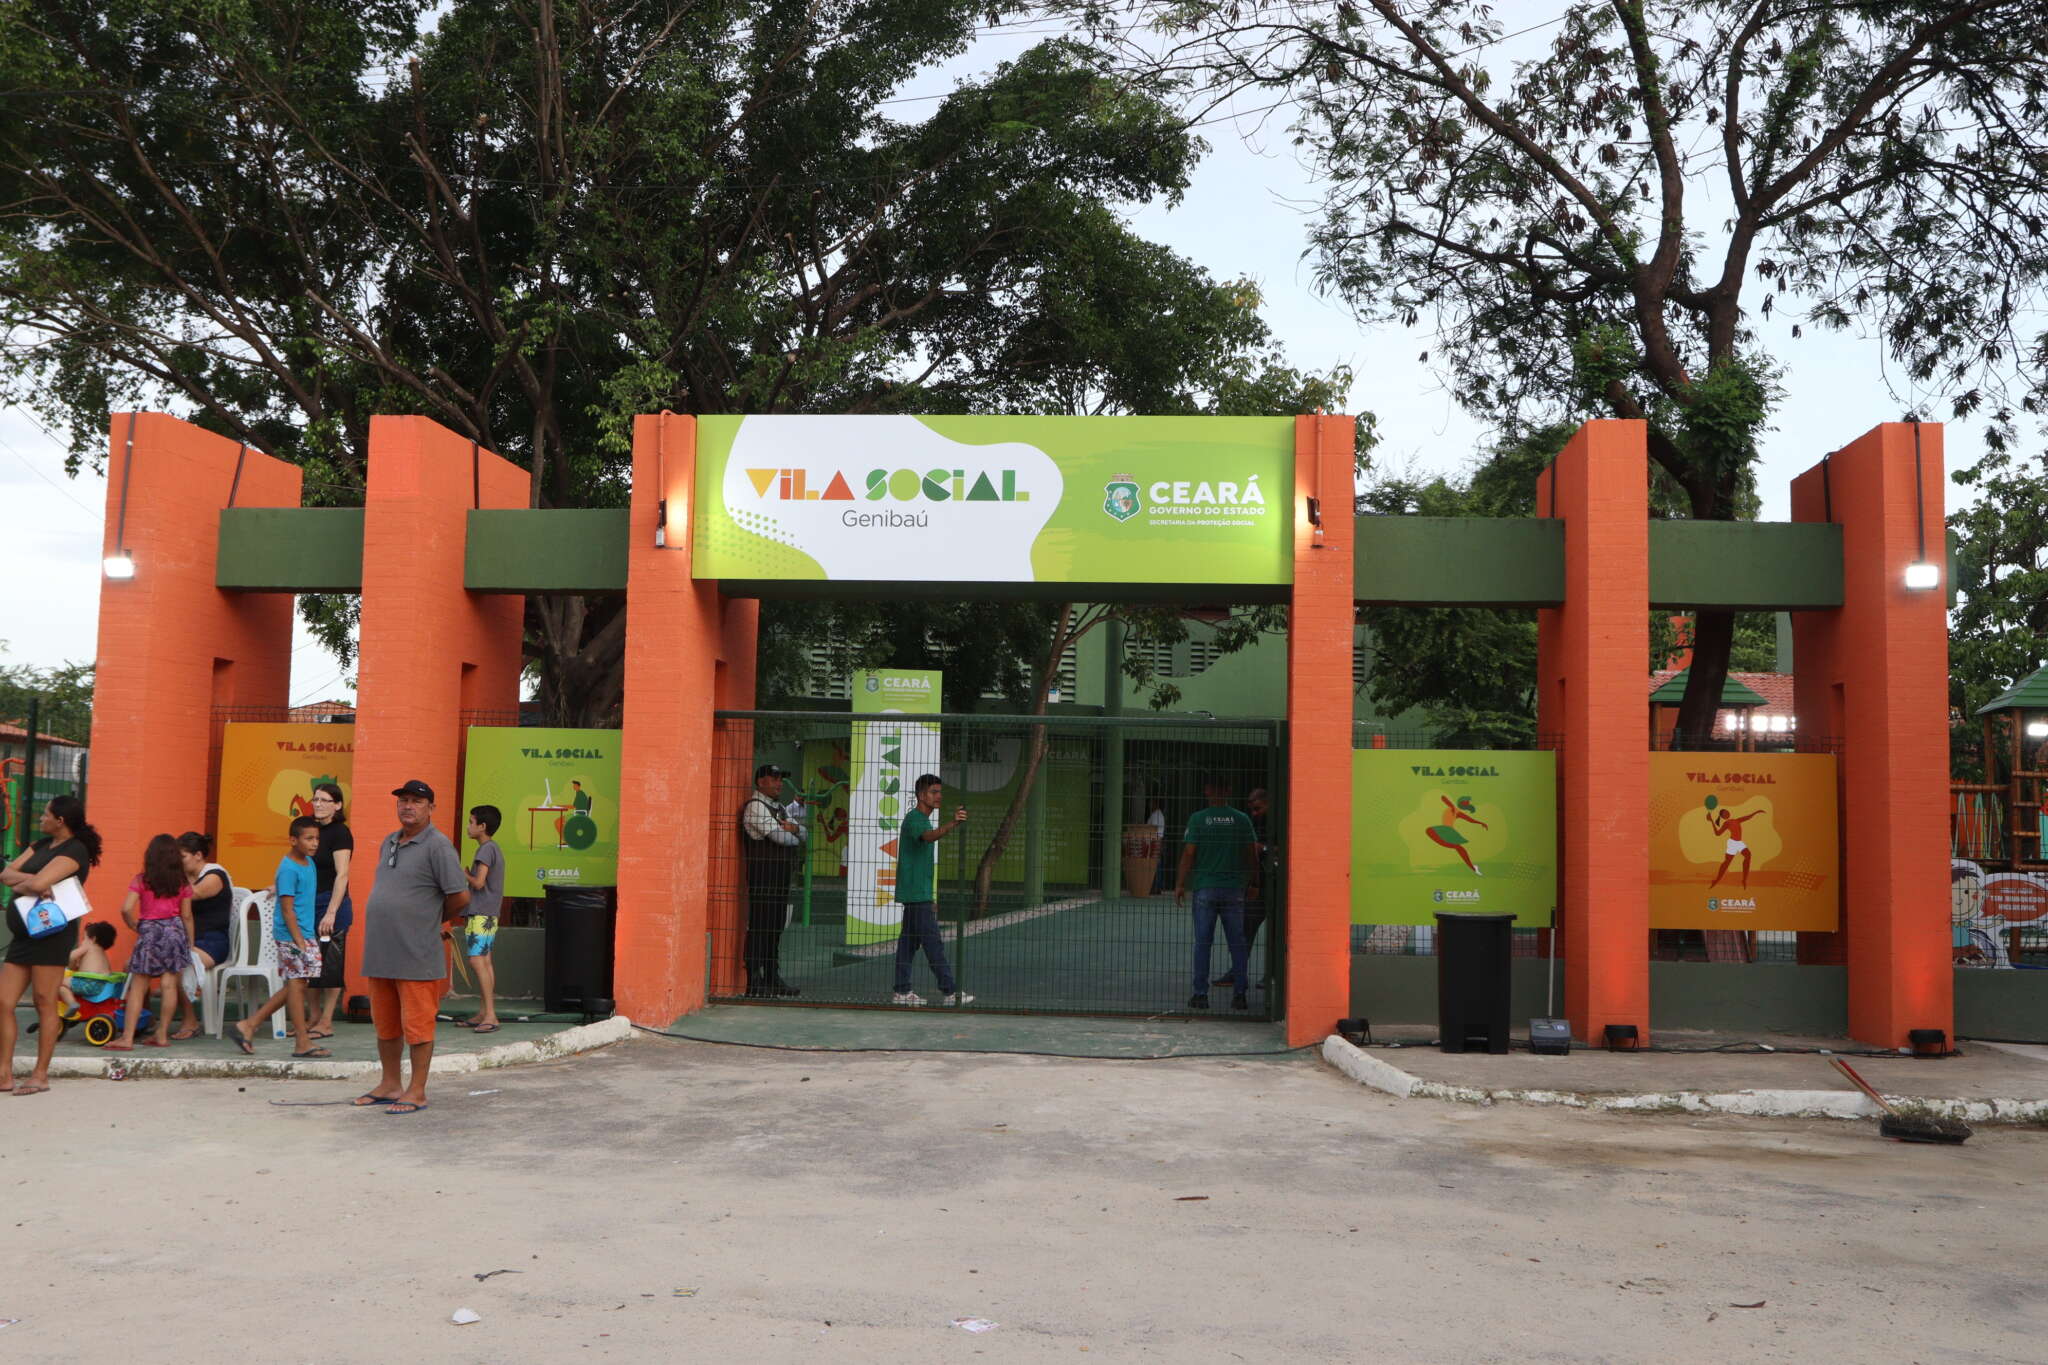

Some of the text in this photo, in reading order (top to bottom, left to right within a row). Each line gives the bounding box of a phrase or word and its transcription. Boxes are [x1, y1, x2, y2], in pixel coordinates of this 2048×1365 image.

[1150, 474, 1265, 505] CEARÁ
[1149, 506, 1266, 515] GOVERNO DO ESTADO
[841, 509, 928, 528] Genibaú
[1197, 518, 1230, 527] PROTEÇÃO
[884, 676, 931, 689] CEARÁ
[548, 867, 580, 876] CEARÁ
[1446, 889, 1480, 898] CEARÁ
[1720, 897, 1756, 907] CEARÁ
